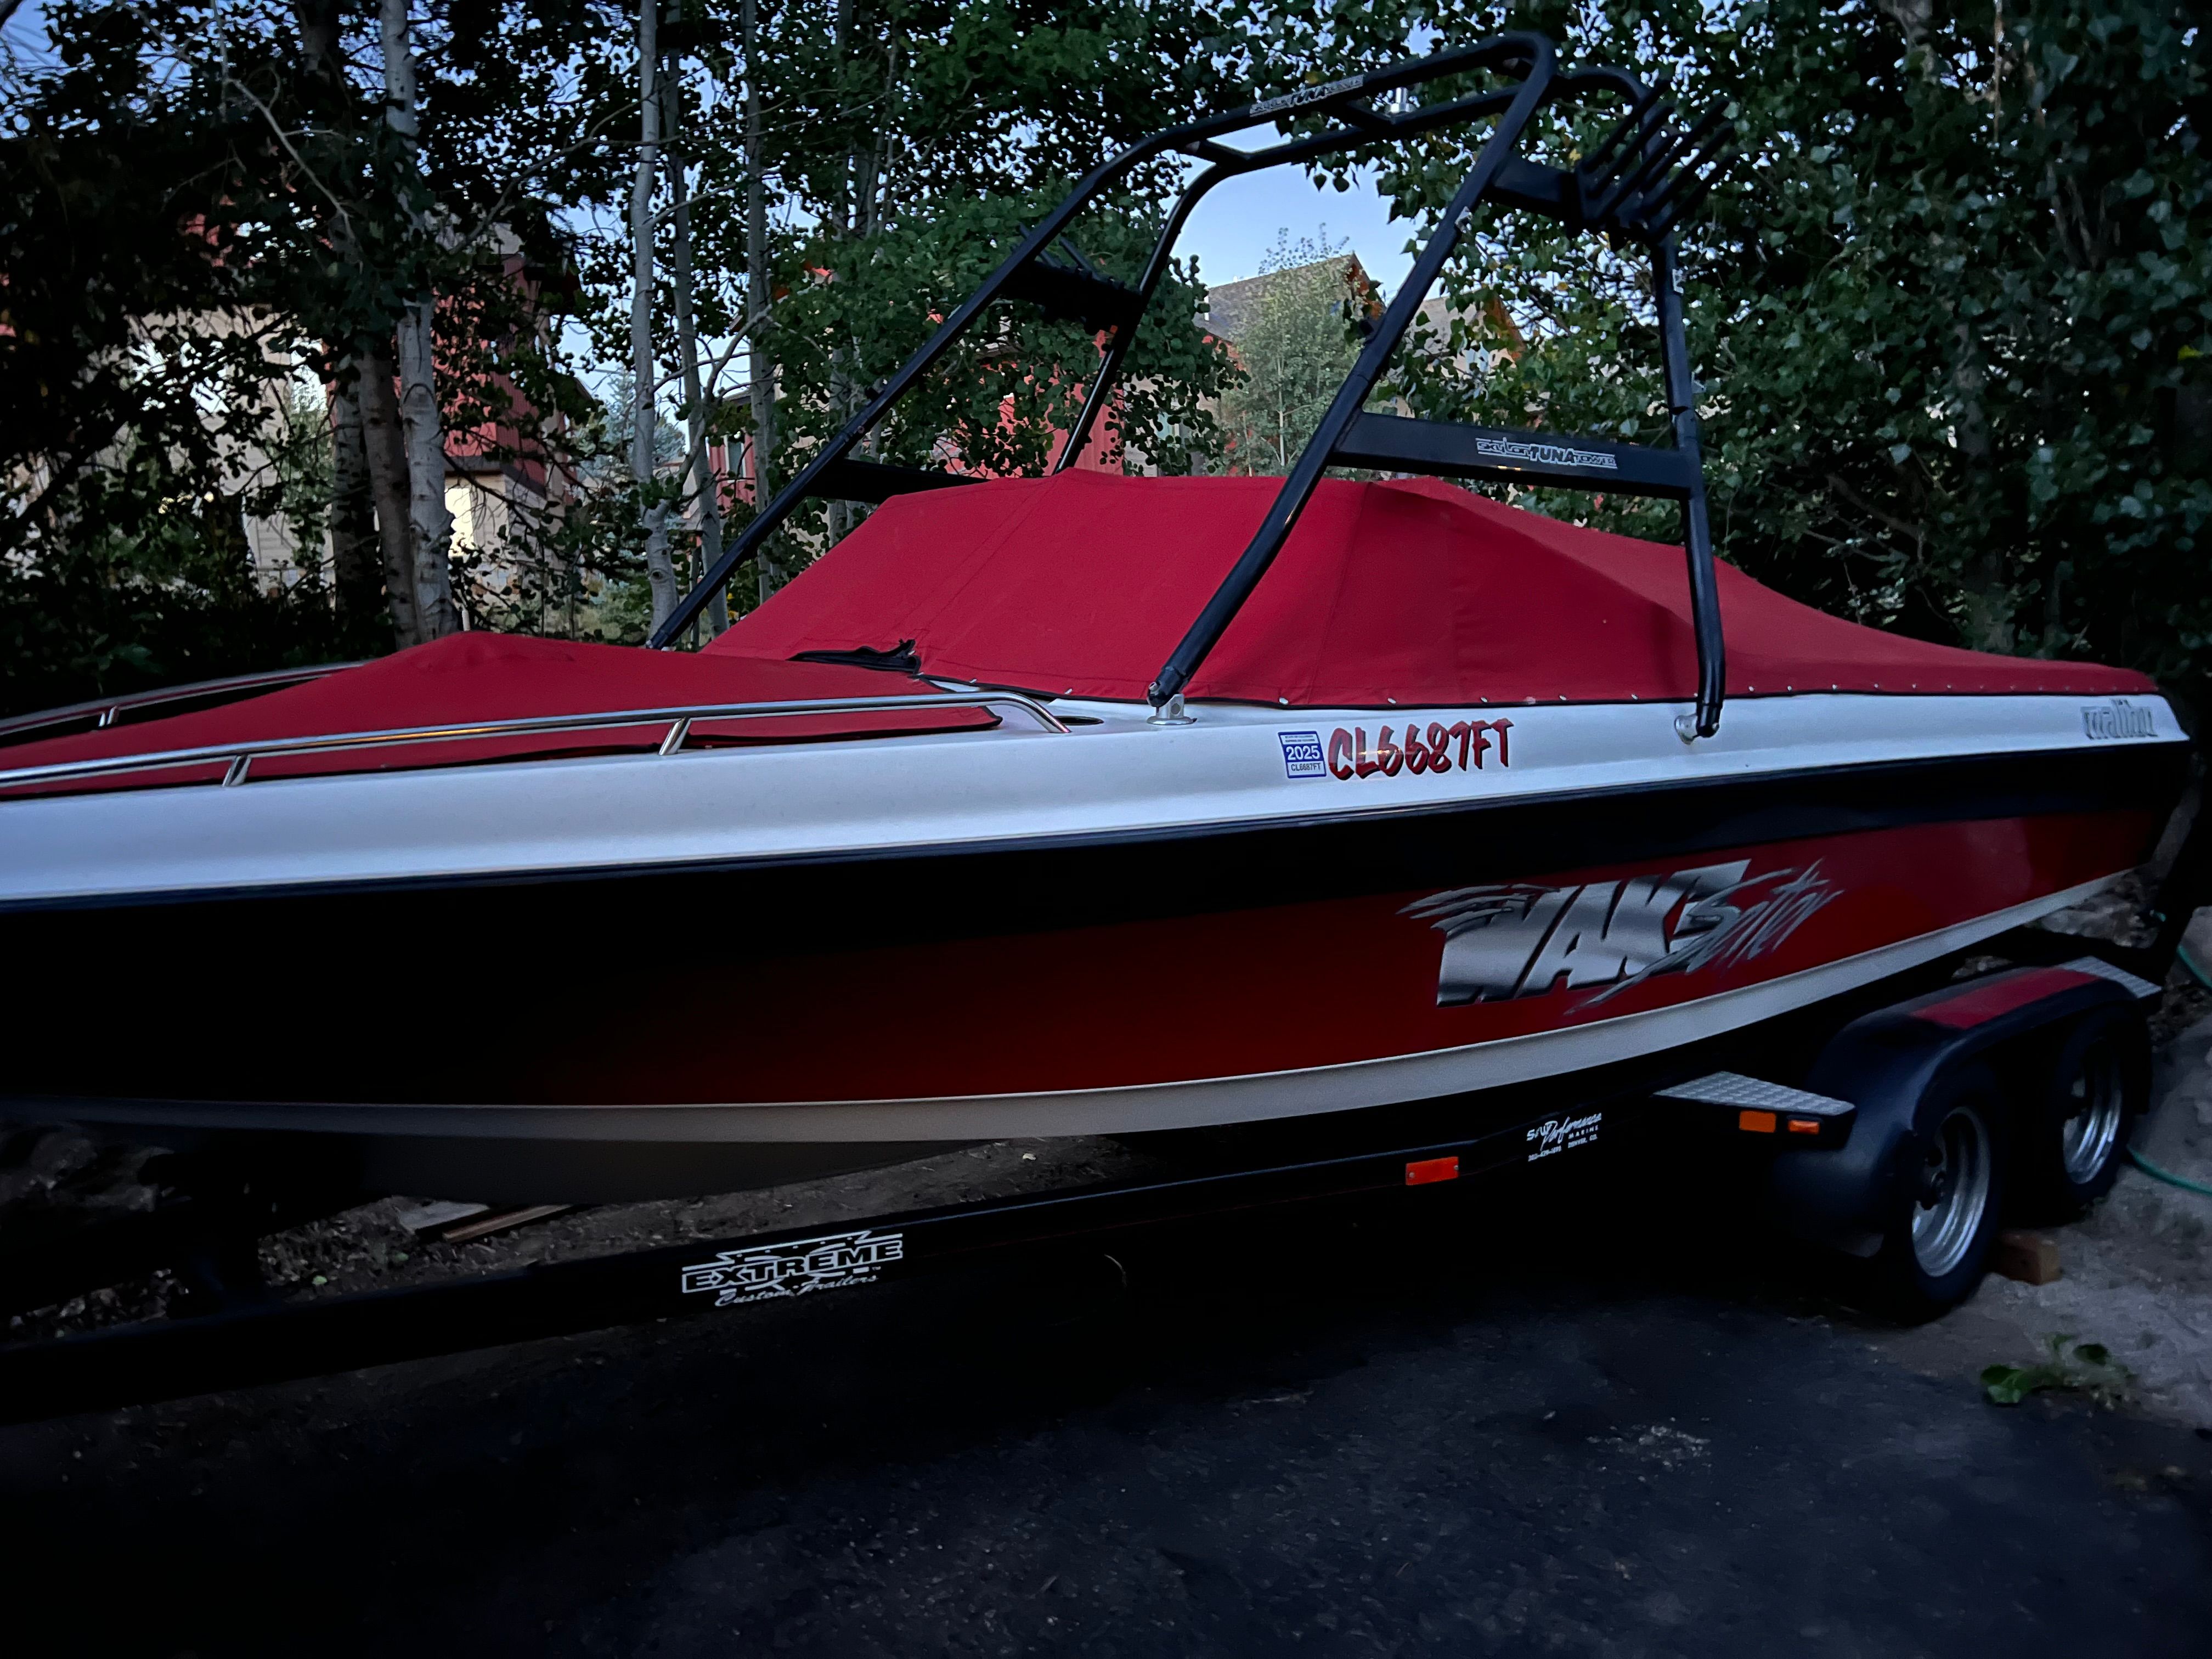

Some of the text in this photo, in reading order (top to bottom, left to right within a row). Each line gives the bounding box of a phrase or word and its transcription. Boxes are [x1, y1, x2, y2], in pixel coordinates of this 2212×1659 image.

[1530, 443, 1577, 465] TUNA
[1286, 745, 1320, 760] 2025
[1328, 718, 1514, 781] CL6687FT
[682, 1240, 903, 1293] EXTREME
